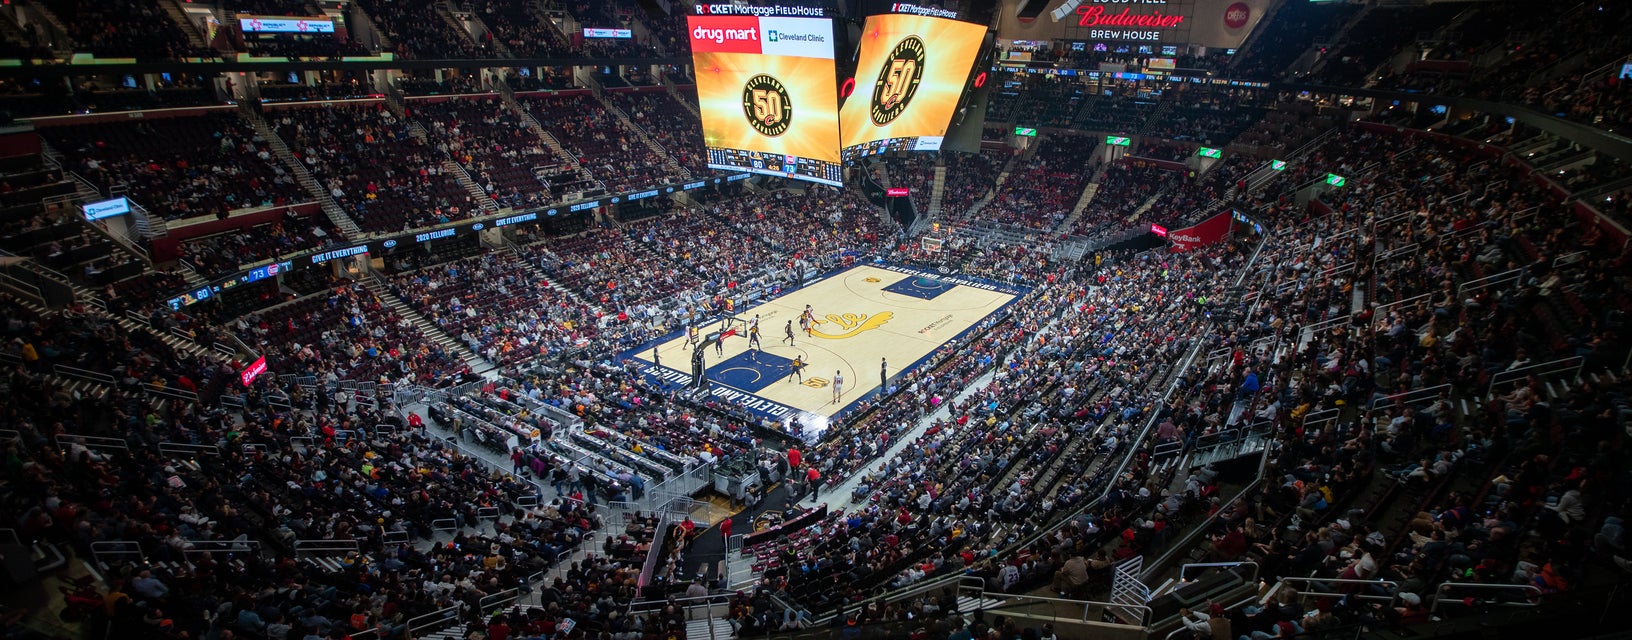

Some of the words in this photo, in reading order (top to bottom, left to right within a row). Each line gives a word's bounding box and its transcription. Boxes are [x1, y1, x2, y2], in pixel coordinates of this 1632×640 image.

[696, 4, 733, 14] ROCKET
[734, 4, 774, 16] Mortgage
[775, 5, 824, 16] FIELDHOUSE
[910, 4, 931, 16] Mortgage
[1076, 5, 1184, 27] Budweiser
[693, 26, 724, 44] drug
[726, 26, 757, 40] mart
[779, 32, 807, 41] Cleveland
[808, 33, 824, 42] Clinic
[1090, 30, 1120, 40] BREW
[1122, 30, 1160, 40] HOUSE
[890, 39, 924, 62] CLEVELAND
[747, 76, 784, 93] CLEVELAND
[881, 59, 916, 105] 50
[752, 89, 782, 122] 50
[872, 103, 904, 123] CAVALIERS
[496, 218, 506, 226] GIVE
[511, 213, 537, 224] EVERYTHING
[416, 233, 429, 242] 2020
[430, 228, 455, 240] TELLURIDE
[1170, 233, 1200, 243] KeyBank
[312, 252, 325, 263] GIVE
[326, 252, 332, 260] IT
[332, 245, 368, 259] EVERYTHING
[253, 270, 264, 279] 73
[887, 265, 940, 279] CLEVELAND
[942, 277, 997, 290] CAVALIERS
[197, 289, 208, 300] 80
[712, 386, 789, 416] CLEVELAND
